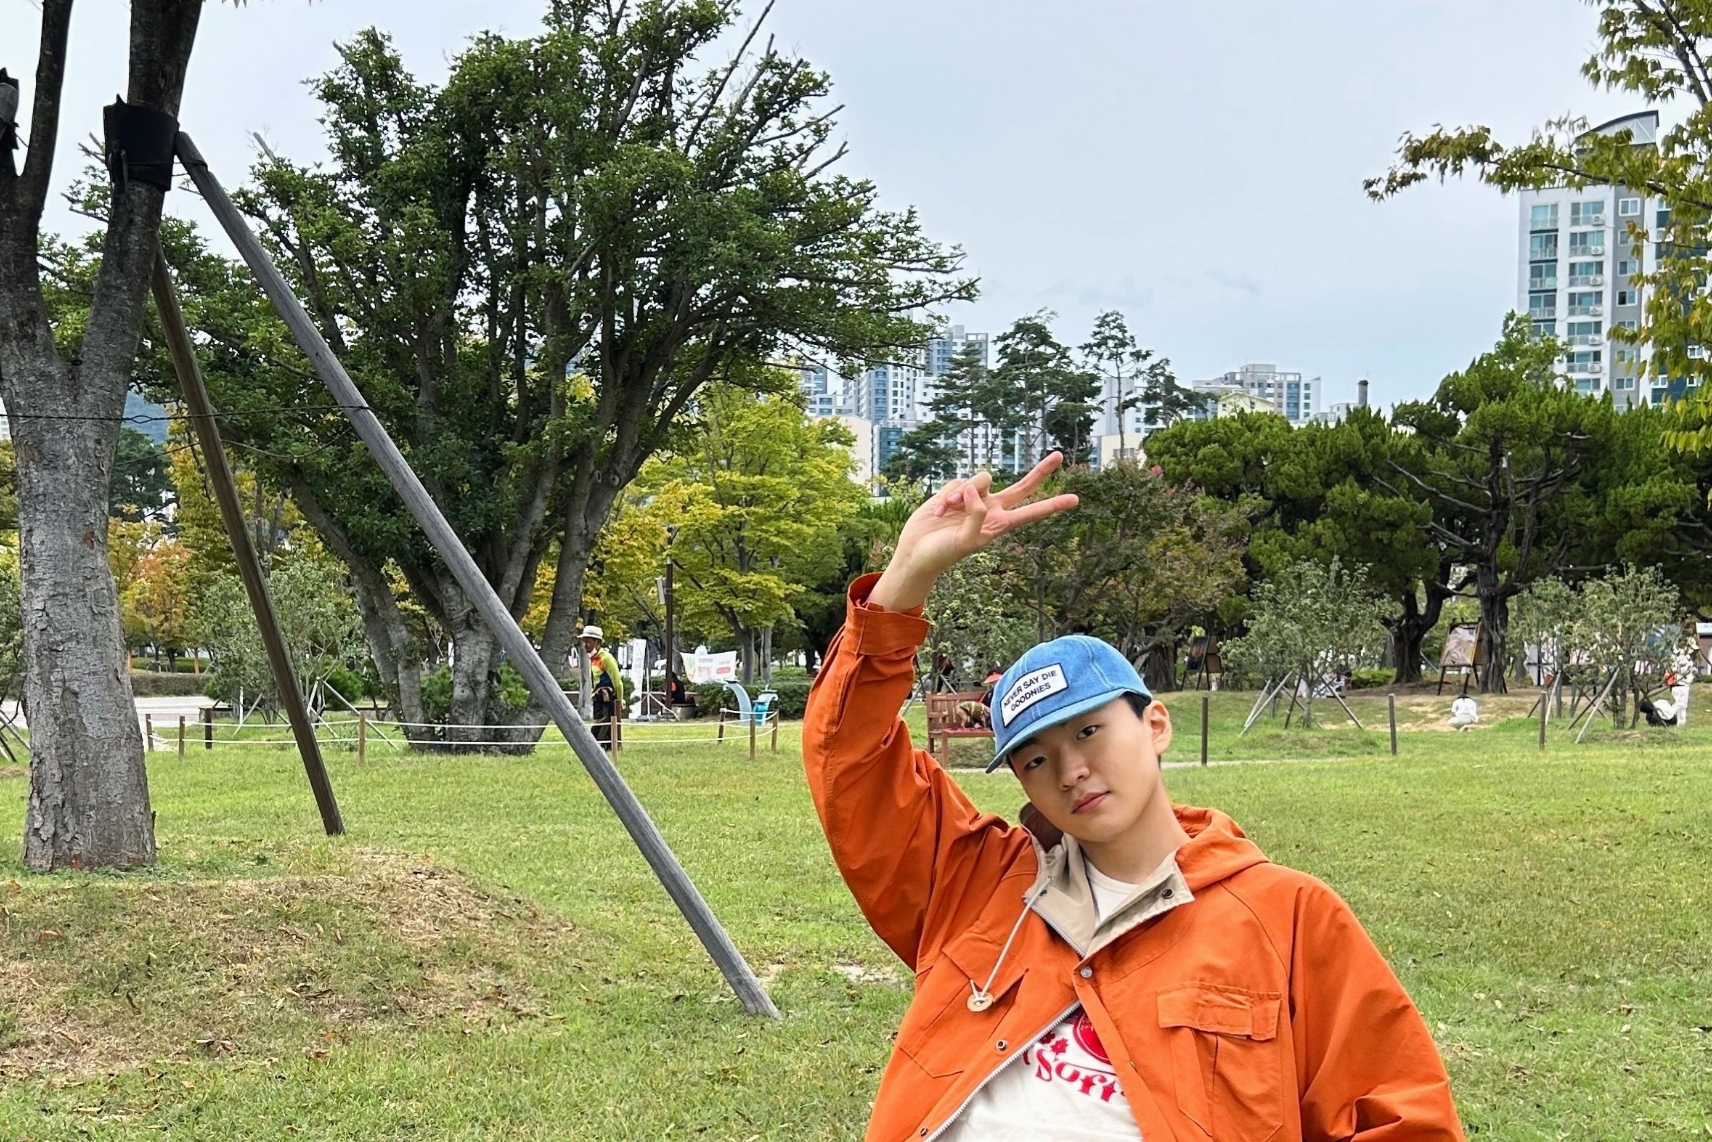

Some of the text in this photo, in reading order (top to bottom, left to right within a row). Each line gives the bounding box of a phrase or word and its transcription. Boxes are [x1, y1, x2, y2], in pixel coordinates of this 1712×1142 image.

[1004, 670, 1057, 708] NEVER SAY DIE
[1010, 682, 1051, 711] GOODNIES
